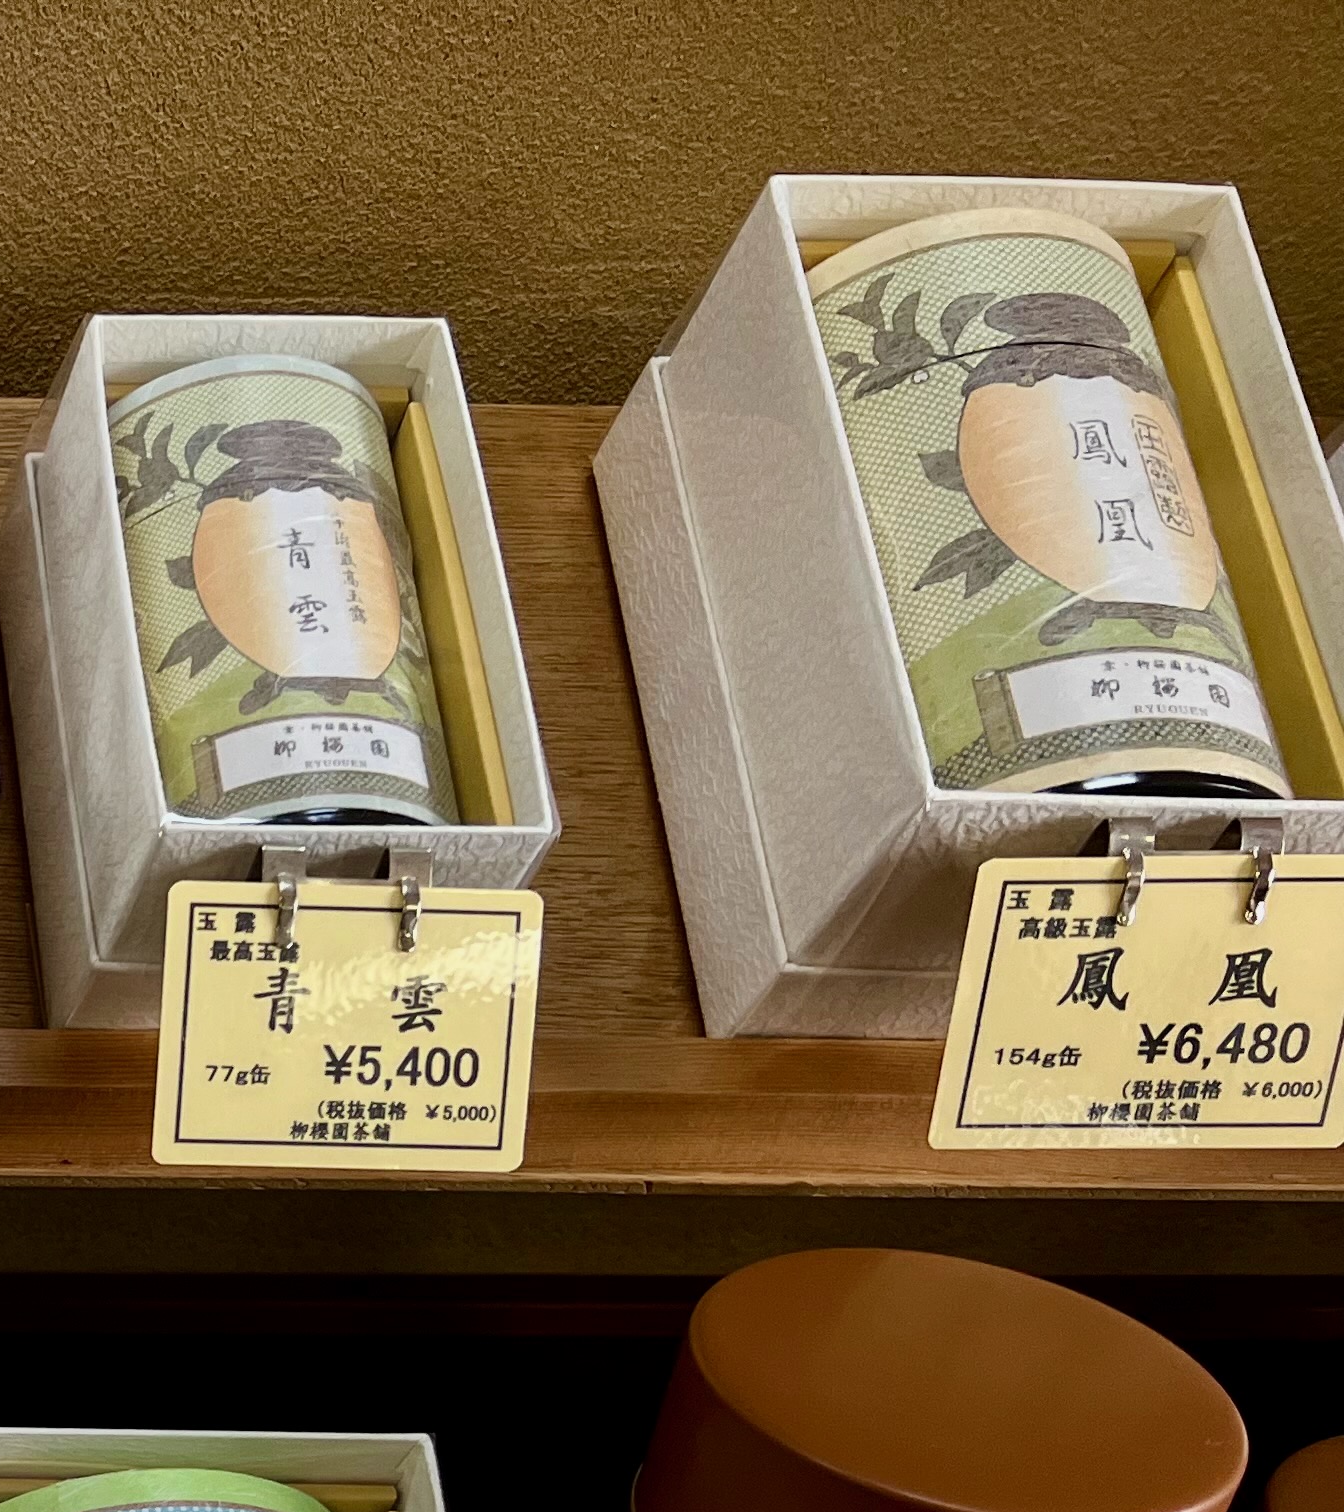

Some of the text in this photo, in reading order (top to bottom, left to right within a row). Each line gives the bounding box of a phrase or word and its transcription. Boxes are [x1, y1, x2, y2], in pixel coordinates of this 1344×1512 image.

[1069, 419, 1154, 552] 鳳凰
[276, 527, 330, 634] 青雲
[1006, 888, 1076, 912] 玉露
[196, 911, 257, 934] 玉露
[1017, 915, 1118, 940] 高級玉露
[209, 939, 301, 964] 最高玉露
[1056, 945, 1279, 1012] 鳳凰
[252, 966, 449, 1035] 青雲
[993, 1021, 1311, 1071] 154g缶 ¥6,480
[204, 1044, 480, 1092] 77g缶 ¥5,400
[1120, 1080, 1324, 1101] (税抜価格 ¥6,000)
[317, 1100, 498, 1123] (税抜価格 ¥5,000)
